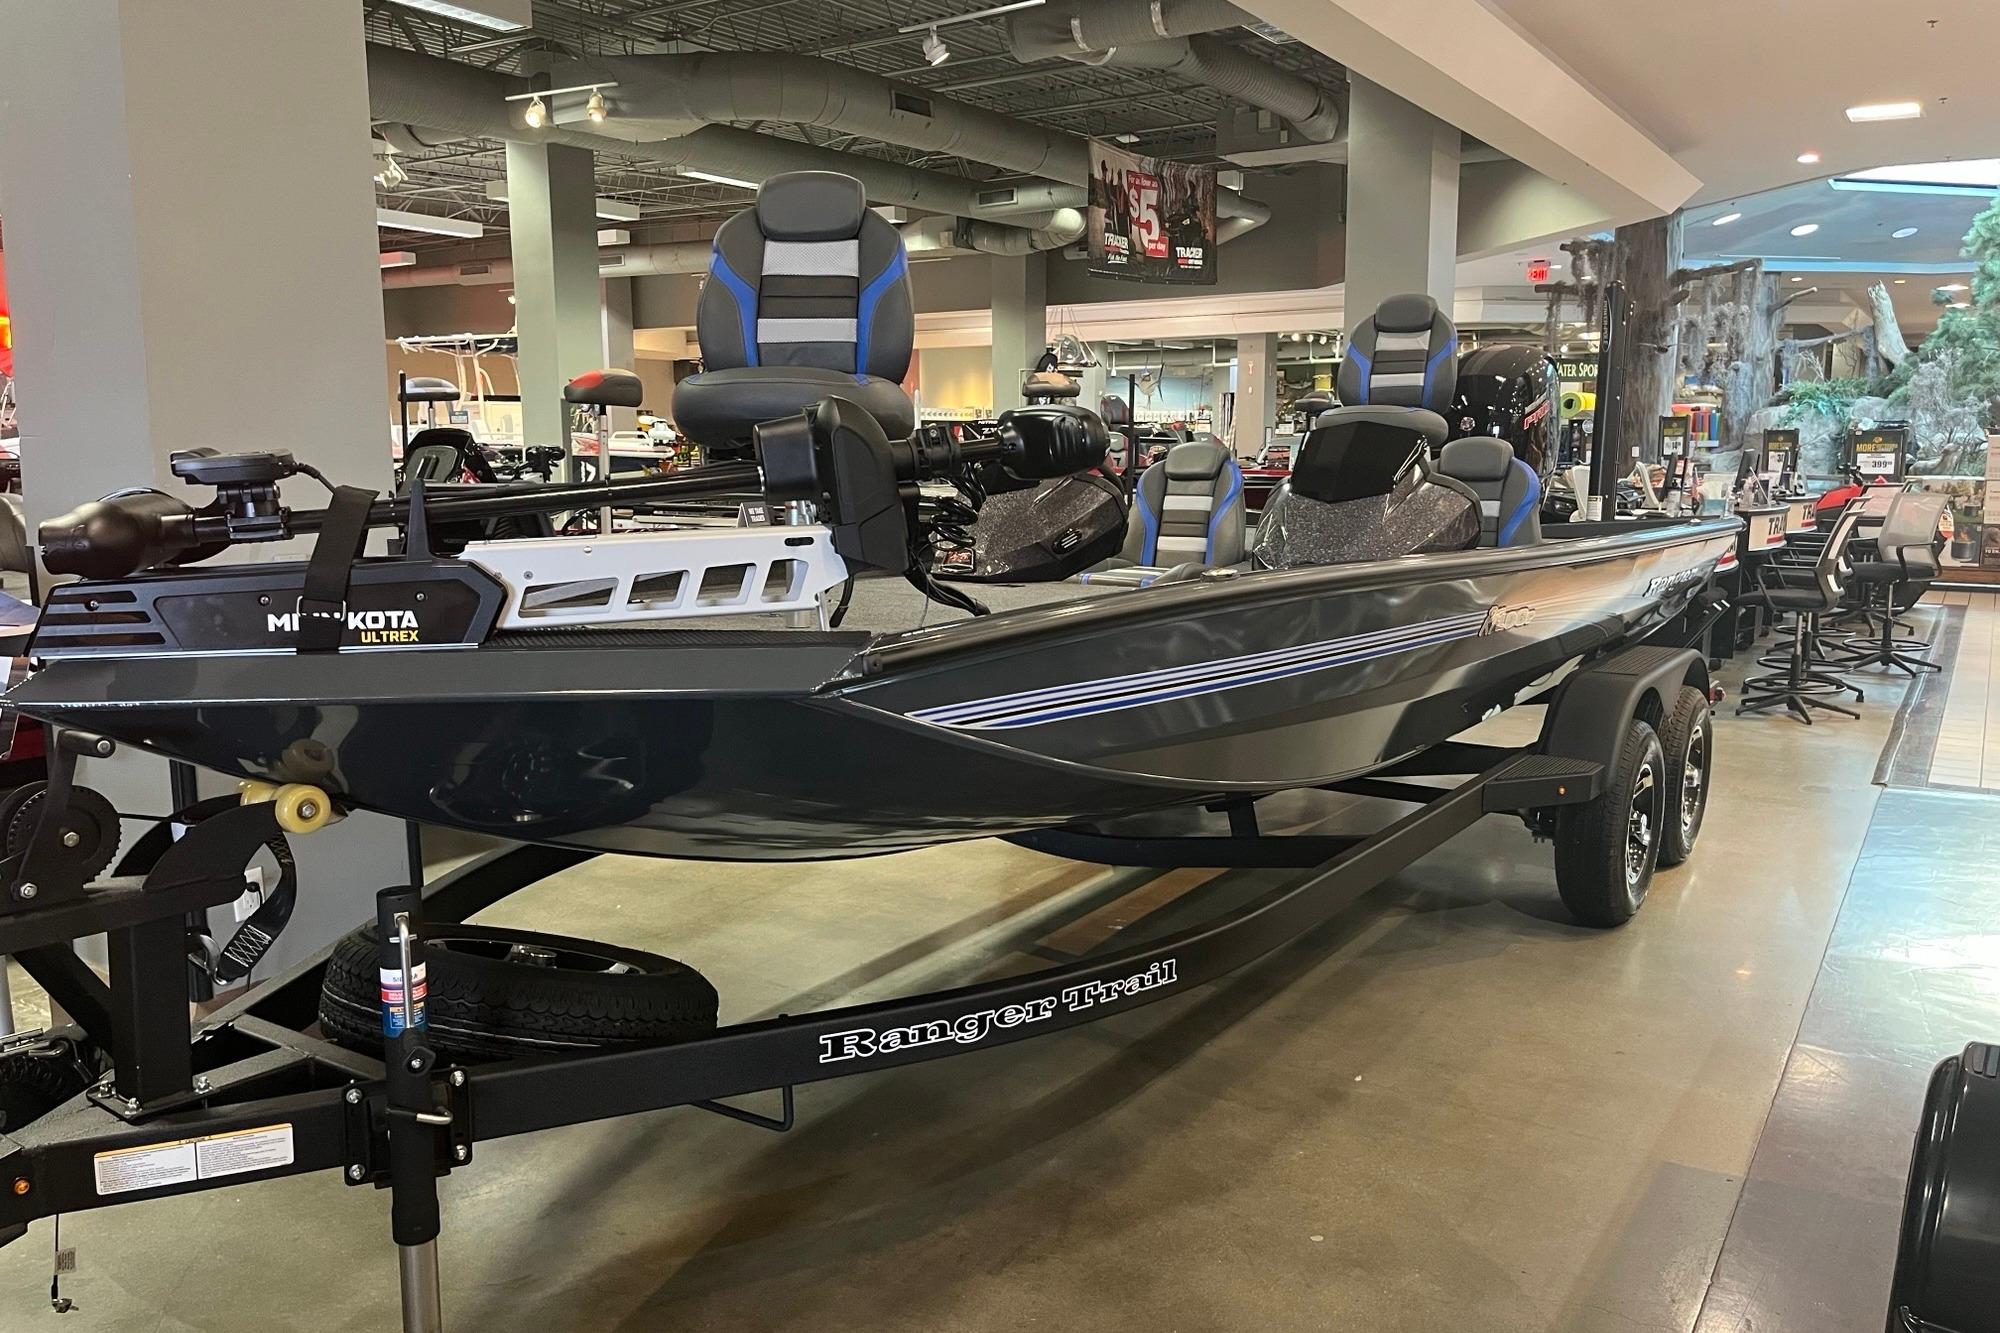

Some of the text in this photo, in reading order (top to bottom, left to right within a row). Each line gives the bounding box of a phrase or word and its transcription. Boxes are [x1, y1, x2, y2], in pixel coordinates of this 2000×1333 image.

[1129, 186, 1160, 249] $5
[1104, 232, 1129, 250] TRACKER
[1175, 246, 1203, 259] TRACKER
[1556, 362, 1577, 377] ATER
[347, 610, 419, 630] KOTA
[361, 629, 419, 643] ULTREX
[819, 958, 1177, 1064] Ranger Trail
